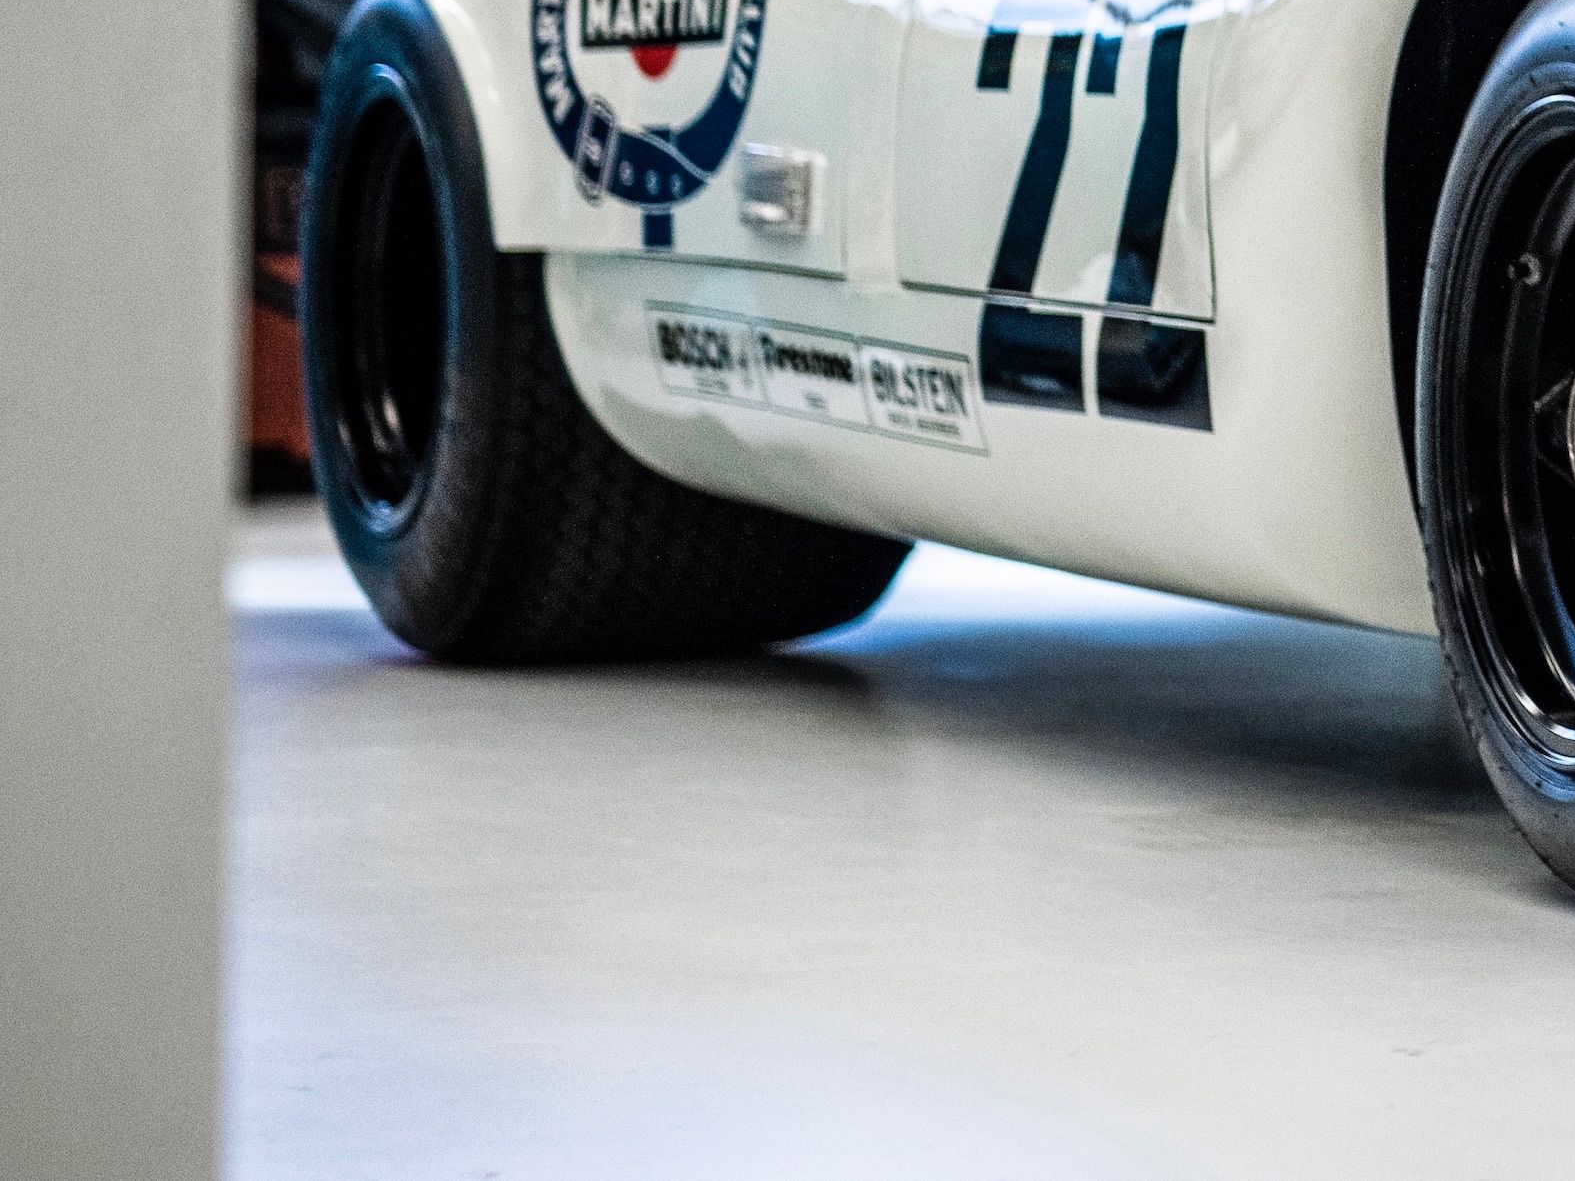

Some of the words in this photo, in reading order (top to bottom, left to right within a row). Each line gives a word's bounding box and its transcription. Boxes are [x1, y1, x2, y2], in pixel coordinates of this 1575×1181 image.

[974, 9, 1214, 433] 22
[657, 320, 734, 370] BOSCH
[870, 358, 968, 417] BILSTEIN
